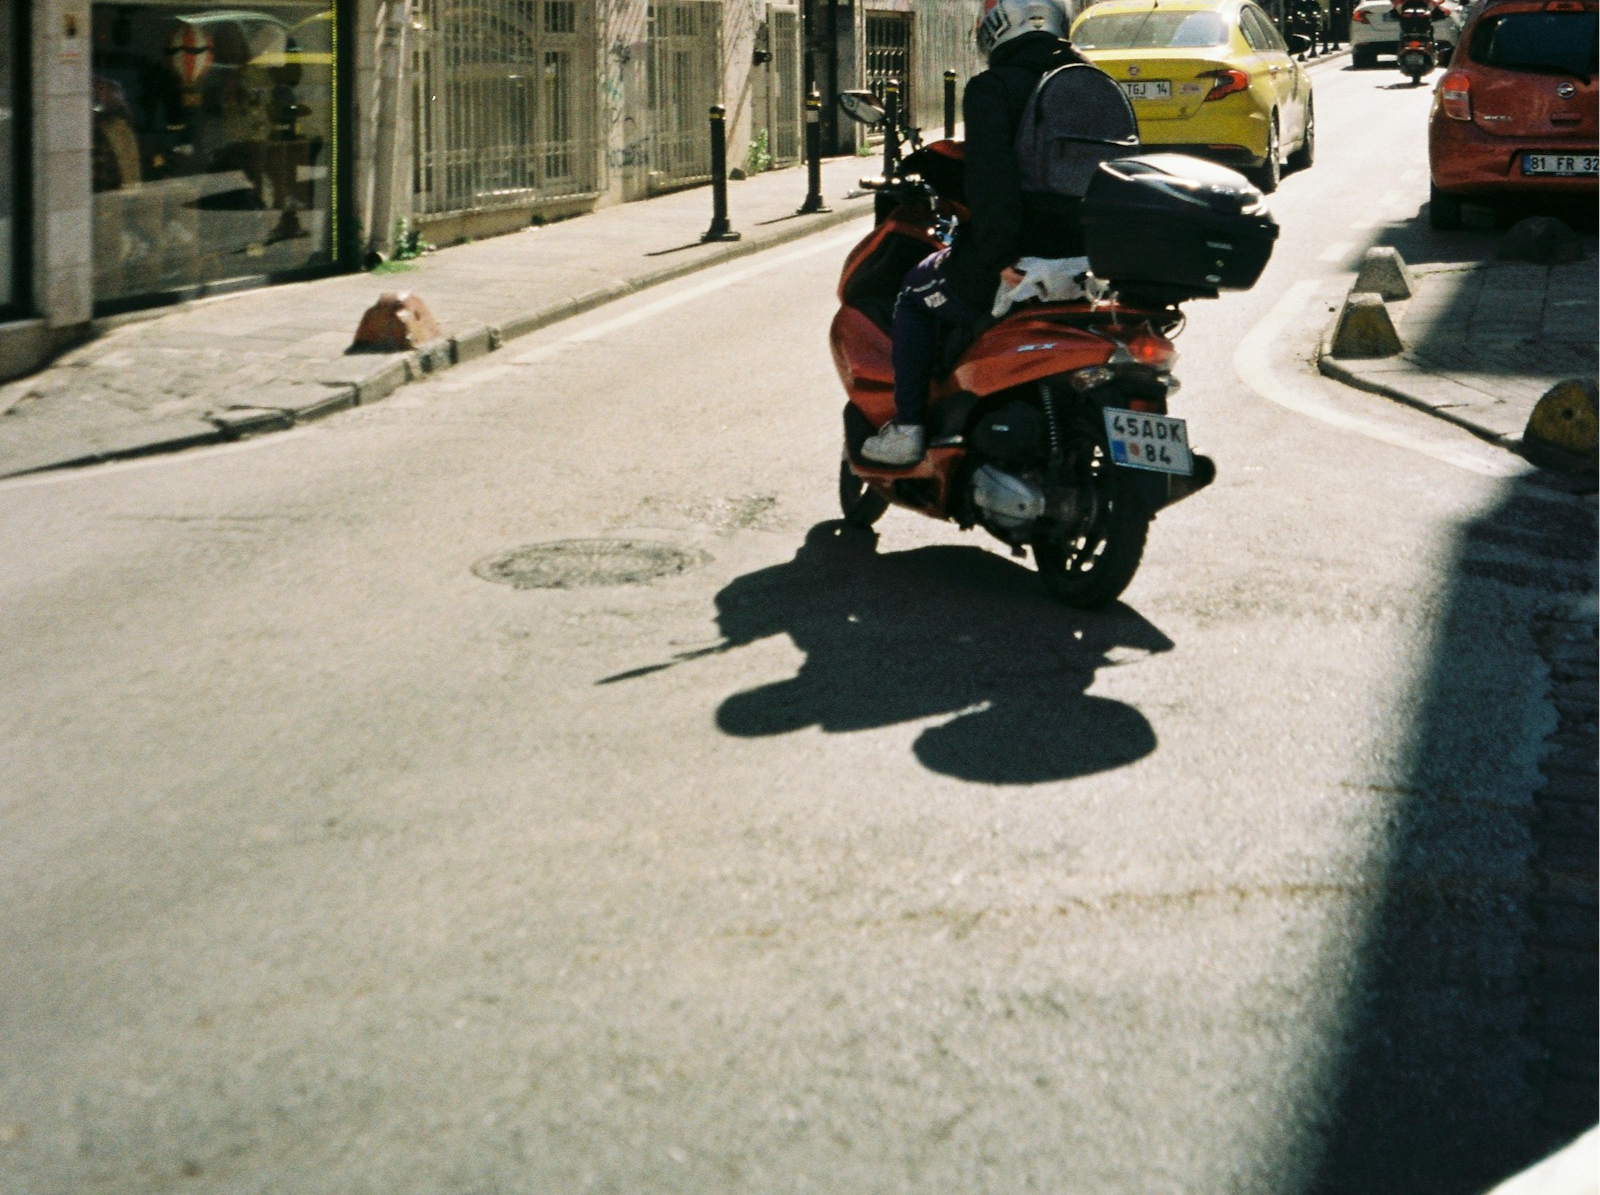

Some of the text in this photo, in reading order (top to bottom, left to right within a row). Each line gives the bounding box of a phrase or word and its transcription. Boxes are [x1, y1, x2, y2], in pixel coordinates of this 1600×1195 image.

[1127, 84, 1147, 95] TGJ
[1157, 84, 1167, 95] 14
[1531, 157, 1546, 170] 81
[1557, 157, 1575, 171] FR
[1145, 444, 1171, 464] 84
